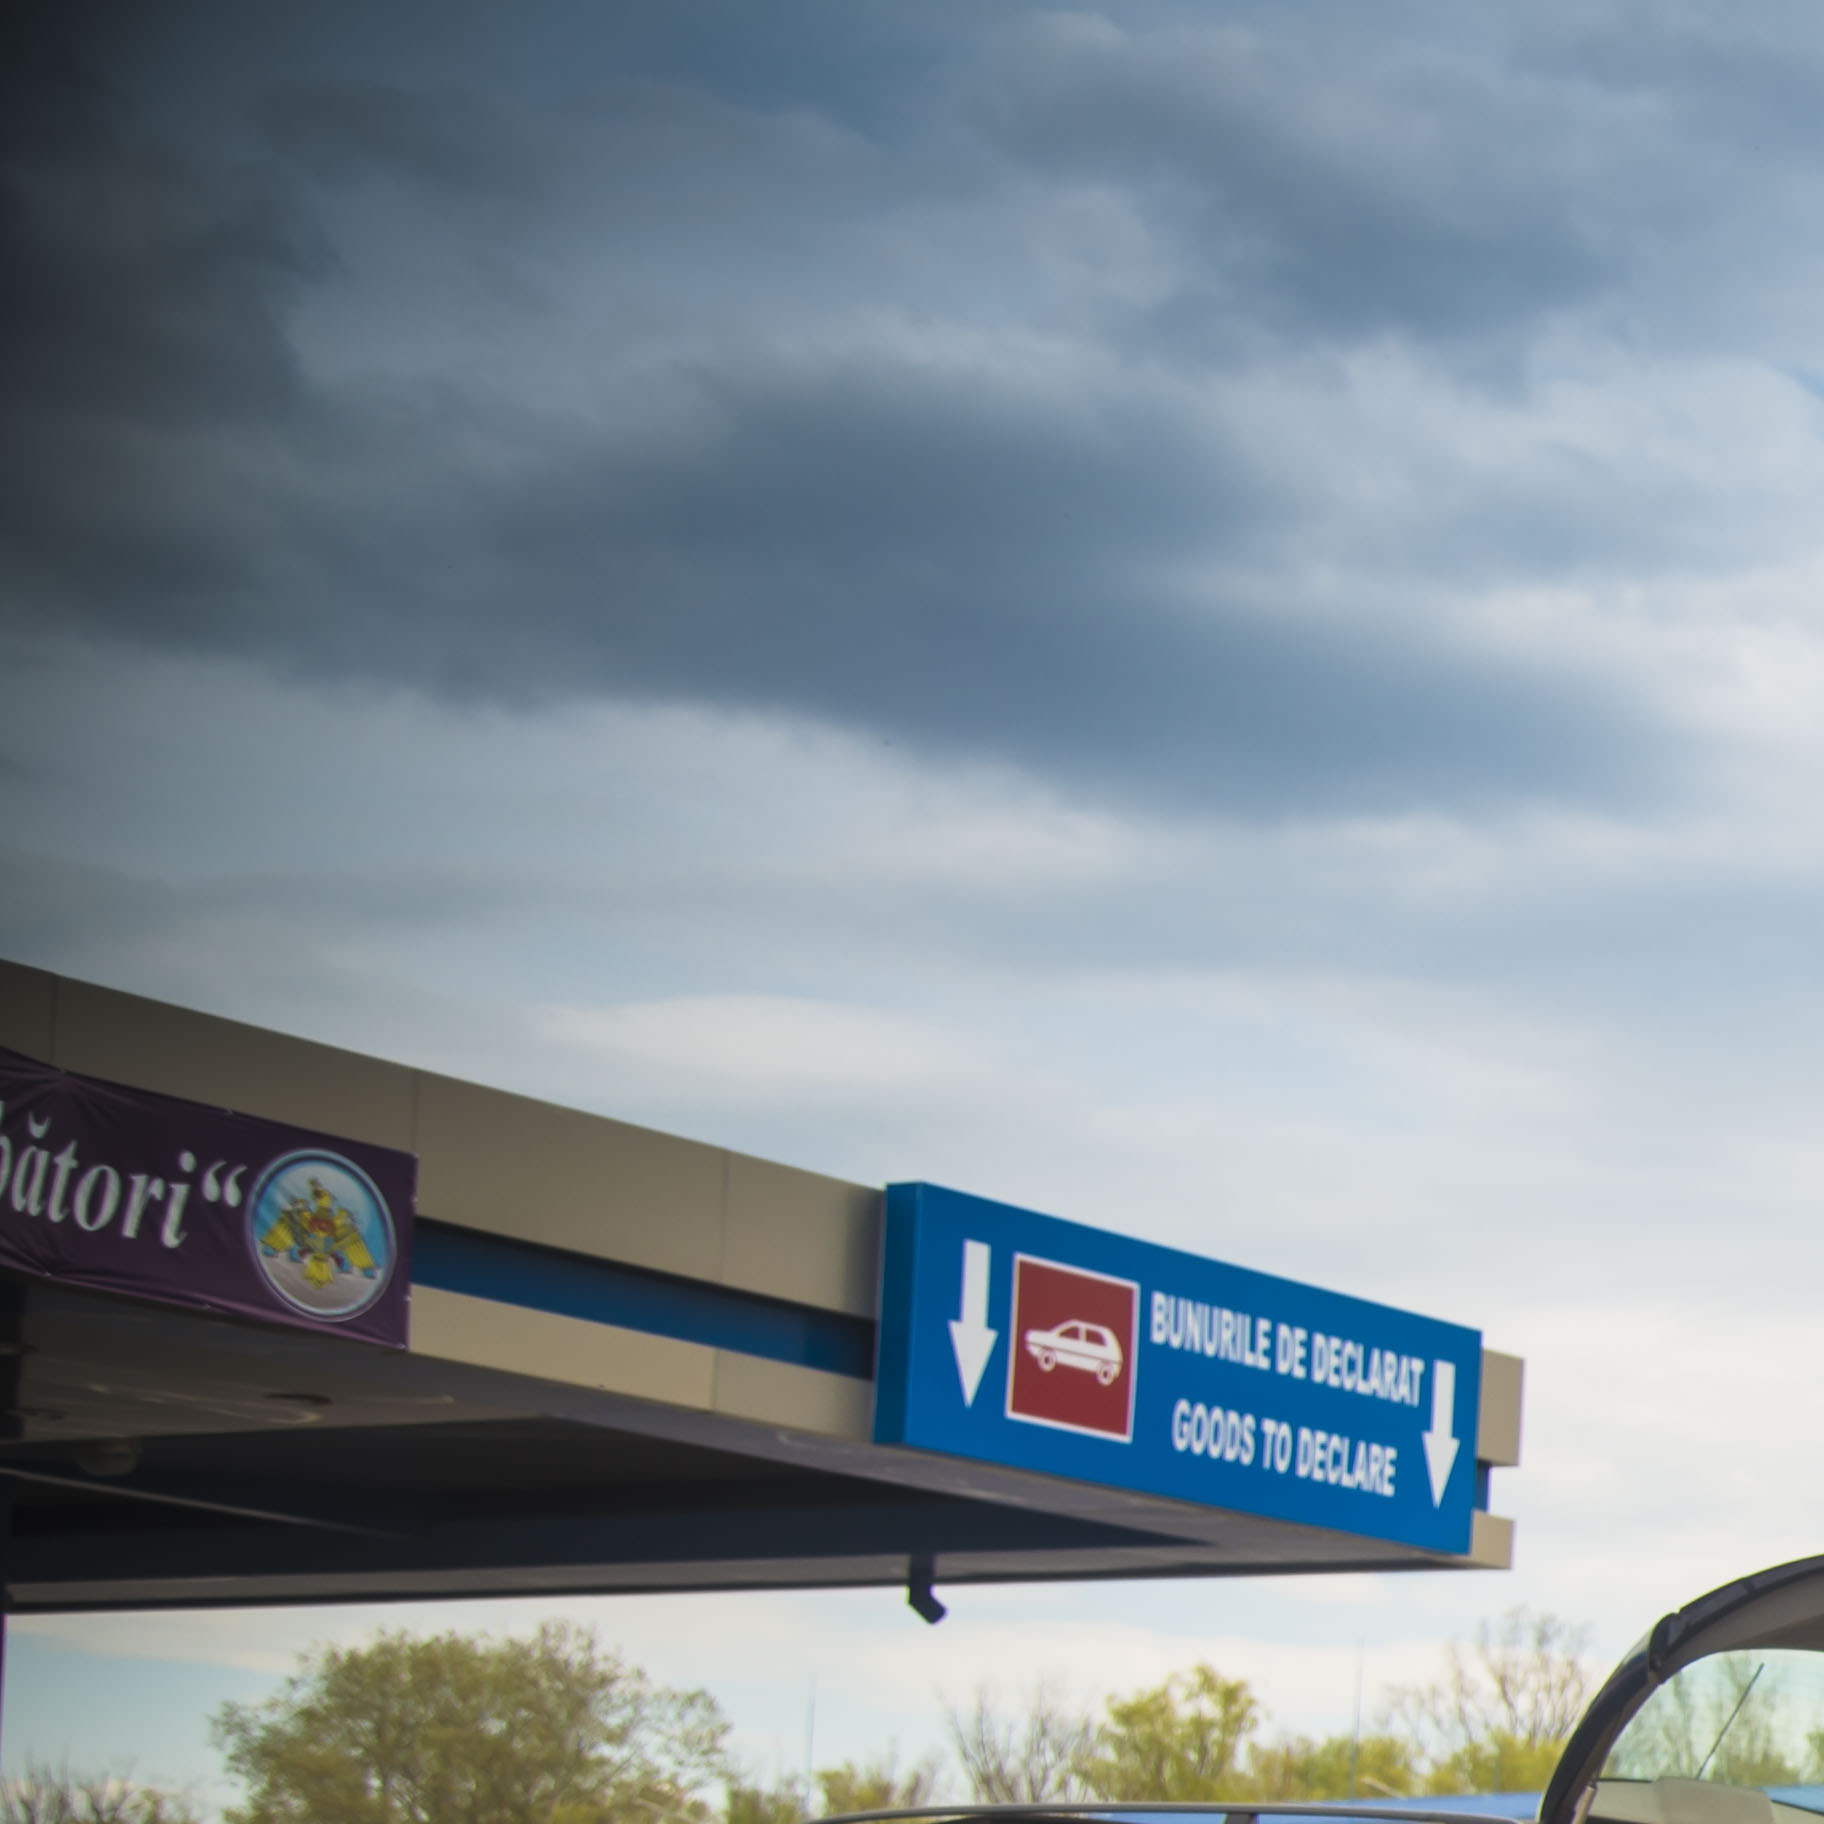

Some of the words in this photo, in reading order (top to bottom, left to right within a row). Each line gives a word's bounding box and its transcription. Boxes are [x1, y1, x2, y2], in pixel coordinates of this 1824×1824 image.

[0, 1101, 248, 1249] ători“
[1151, 1290, 1272, 1370] BUNURILE
[1275, 1323, 1307, 1380] DE
[1311, 1332, 1425, 1408] DECLARAT
[1172, 1398, 1257, 1467] GOODS
[1261, 1417, 1292, 1475] TO
[1296, 1427, 1397, 1497] DECLARE
